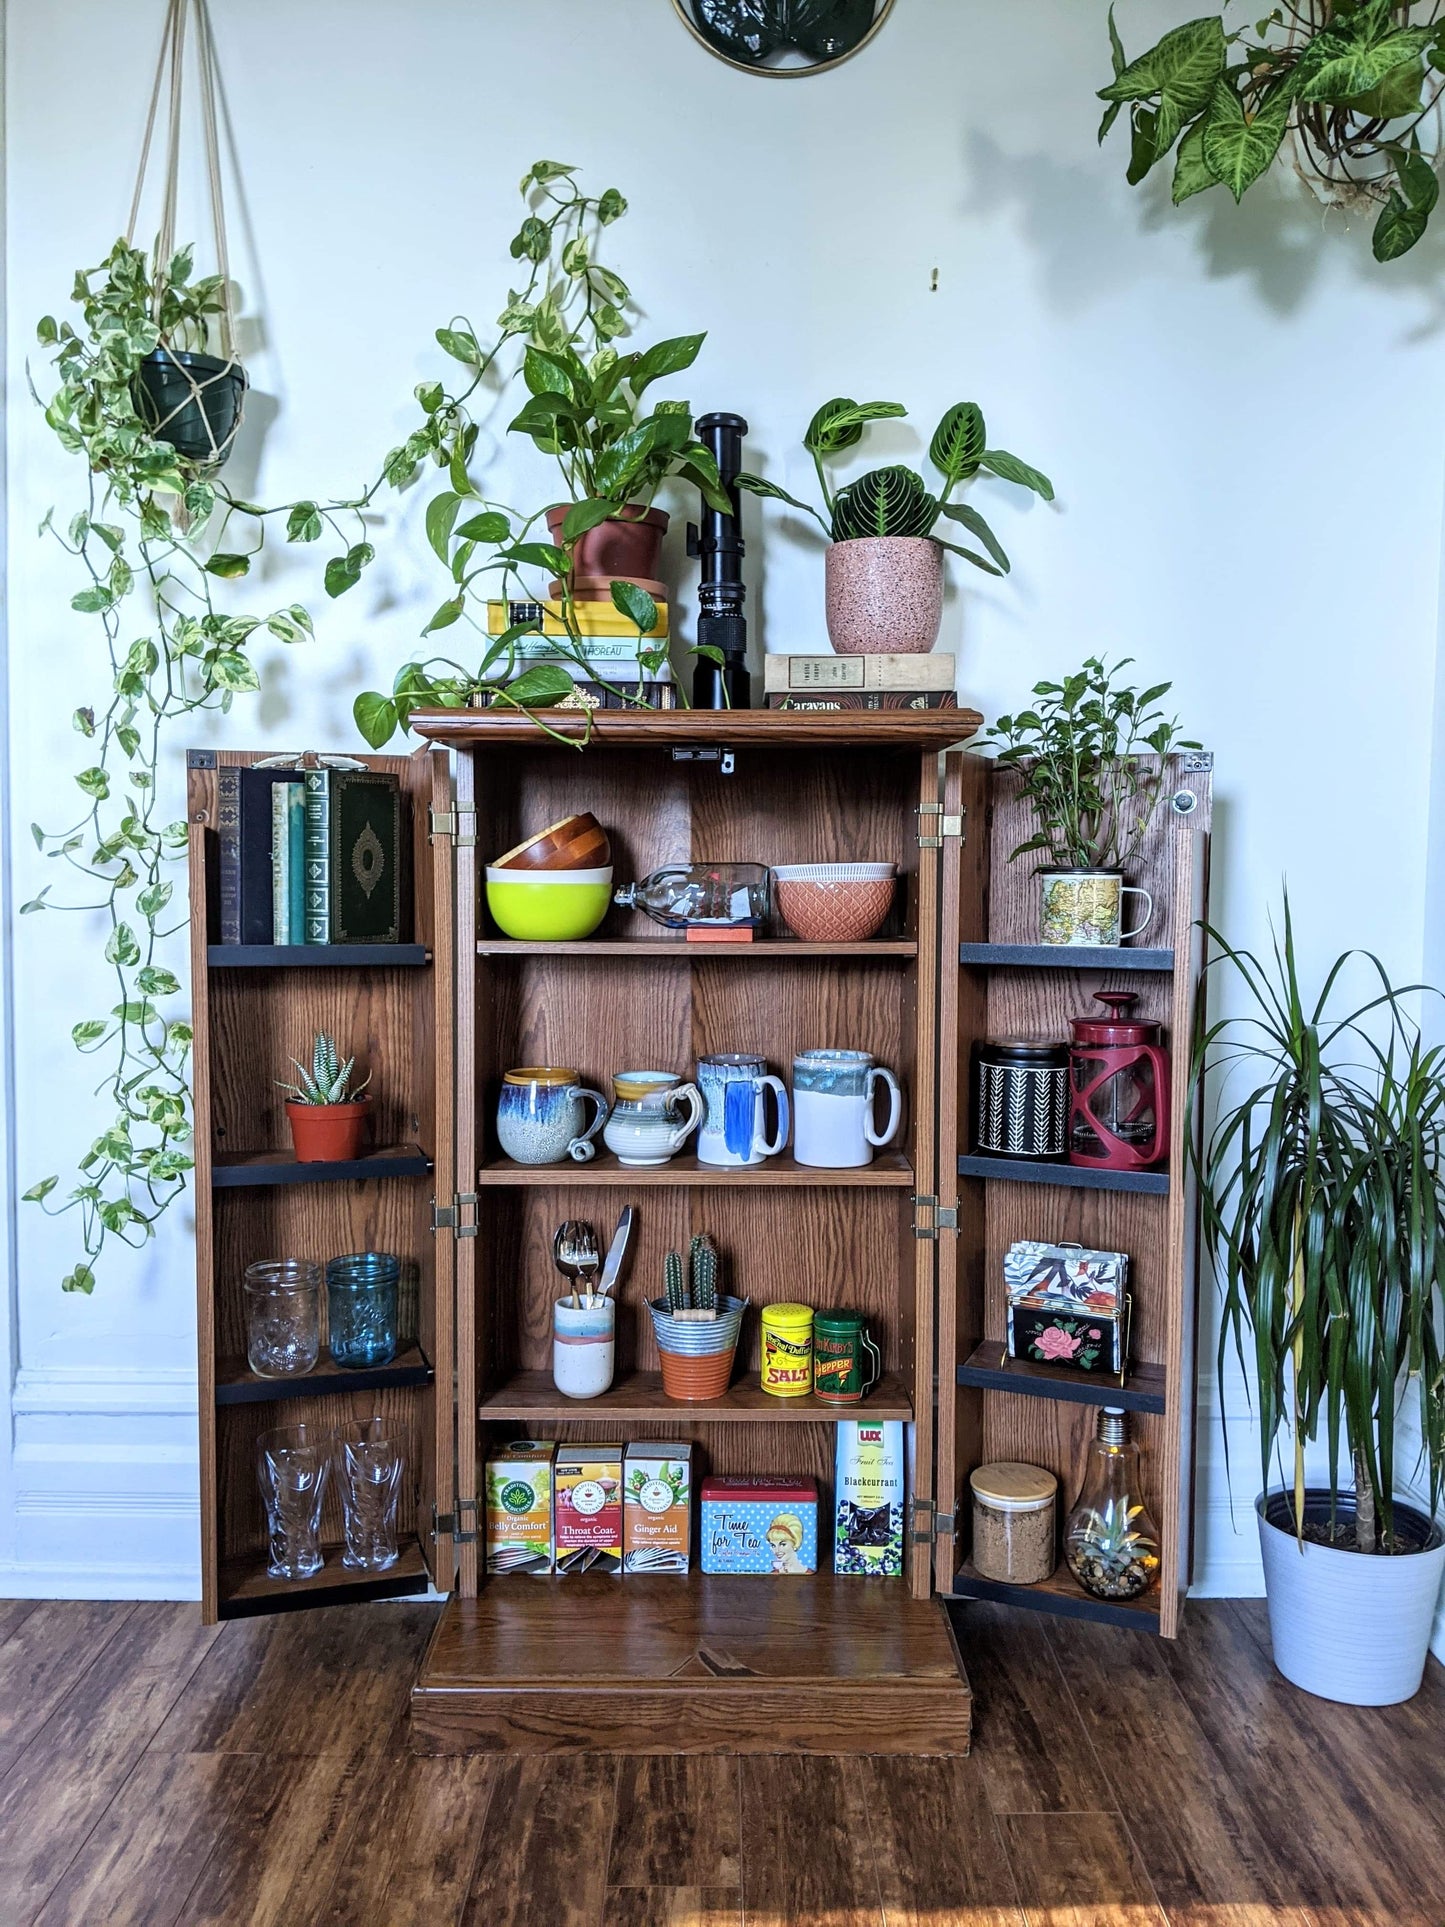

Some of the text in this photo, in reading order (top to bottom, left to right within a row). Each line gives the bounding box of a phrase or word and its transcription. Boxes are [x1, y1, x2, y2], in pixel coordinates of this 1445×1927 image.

[582, 645, 622, 656] THOREAU
[784, 698, 841, 710] Caravans
[767, 1365, 810, 1384] SALT
[849, 1455, 895, 1466] Fruit Tea
[642, 1481, 672, 1494] TRADITIONAL
[844, 1476, 898, 1487] Blackcurrant
[503, 1482, 533, 1496] TRADITIONAL
[574, 1482, 604, 1496] TRADITIONAL
[574, 1500, 604, 1513] MEDICINALS
[642, 1499, 672, 1511] MEDICINALS
[489, 1521, 547, 1532] Belly Comfort
[713, 1514, 749, 1530] Time
[561, 1525, 591, 1535] Throat
[634, 1524, 678, 1535] Ginger Aid
[711, 1531, 731, 1554] for
[733, 1532, 761, 1548] Tea
